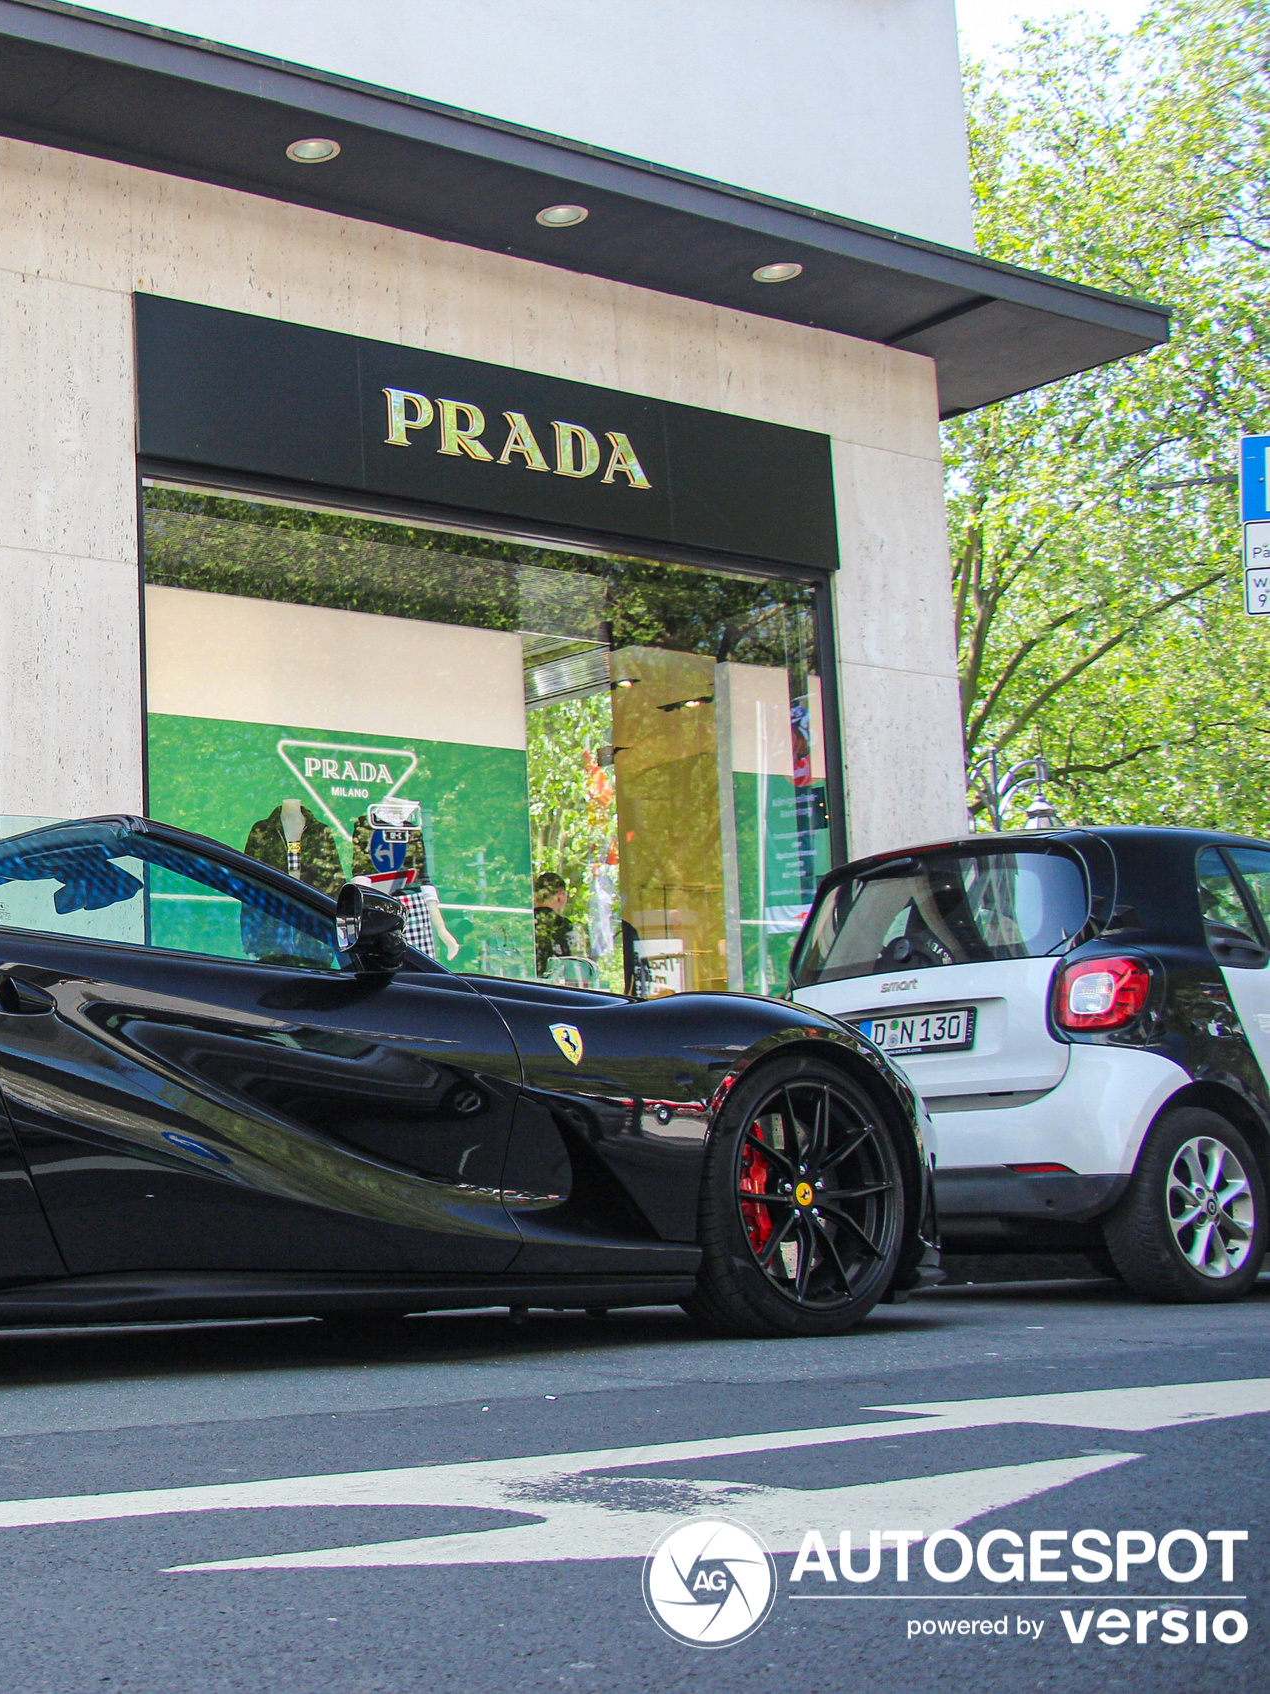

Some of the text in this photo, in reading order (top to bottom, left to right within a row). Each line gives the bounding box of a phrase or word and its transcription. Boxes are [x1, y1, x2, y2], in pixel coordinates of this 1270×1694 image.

[382, 387, 652, 490] PRADA
[304, 757, 394, 785] PRADA
[331, 786, 370, 799] MILANO
[880, 978, 918, 993] smart
[874, 1023, 886, 1046] D
[900, 1020, 914, 1044] N
[919, 1015, 961, 1042] 130
